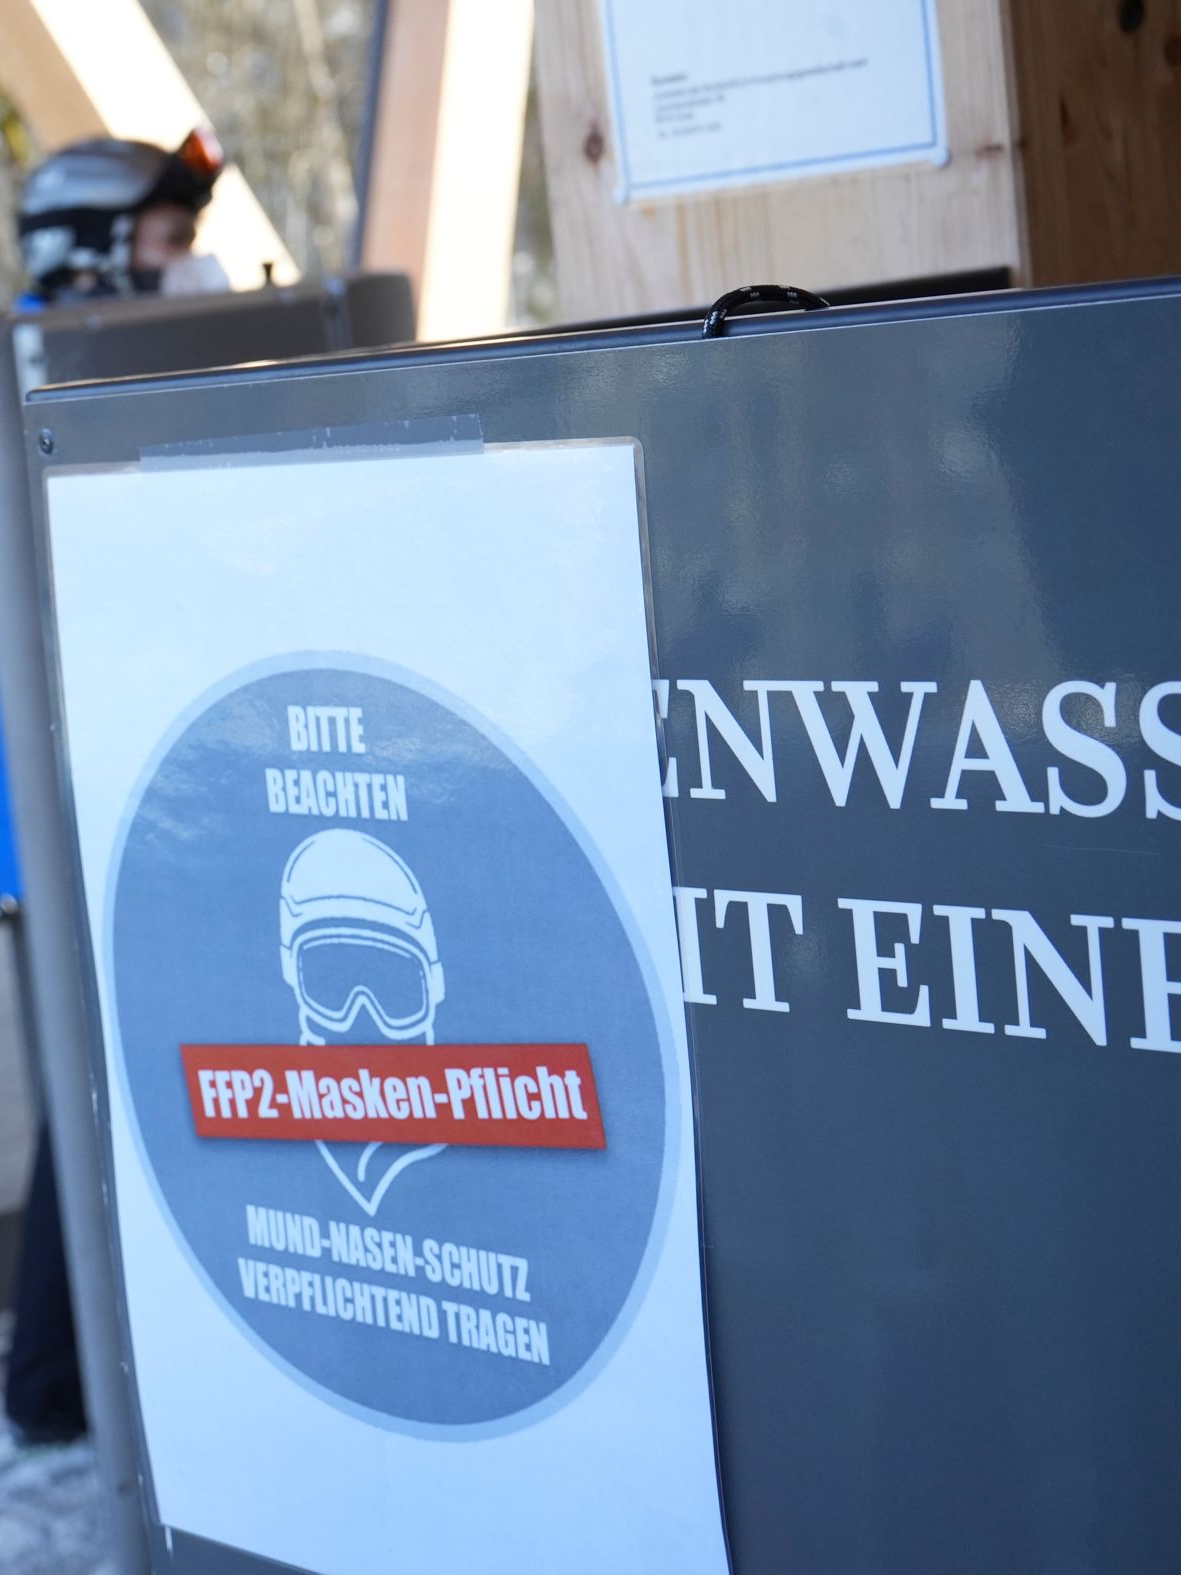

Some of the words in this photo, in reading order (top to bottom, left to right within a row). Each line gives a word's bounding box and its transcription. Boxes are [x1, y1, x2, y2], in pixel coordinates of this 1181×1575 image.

[287, 705, 365, 753] BITTE
[265, 769, 408, 821] BEACHTEN
[198, 1067, 587, 1121] FFP2-Masken-Pflicht
[246, 1204, 530, 1301] MUND-NASEN-SCHUTZ
[238, 1258, 439, 1340] VERPFLICHTEND
[442, 1299, 550, 1365] TRAGEN
